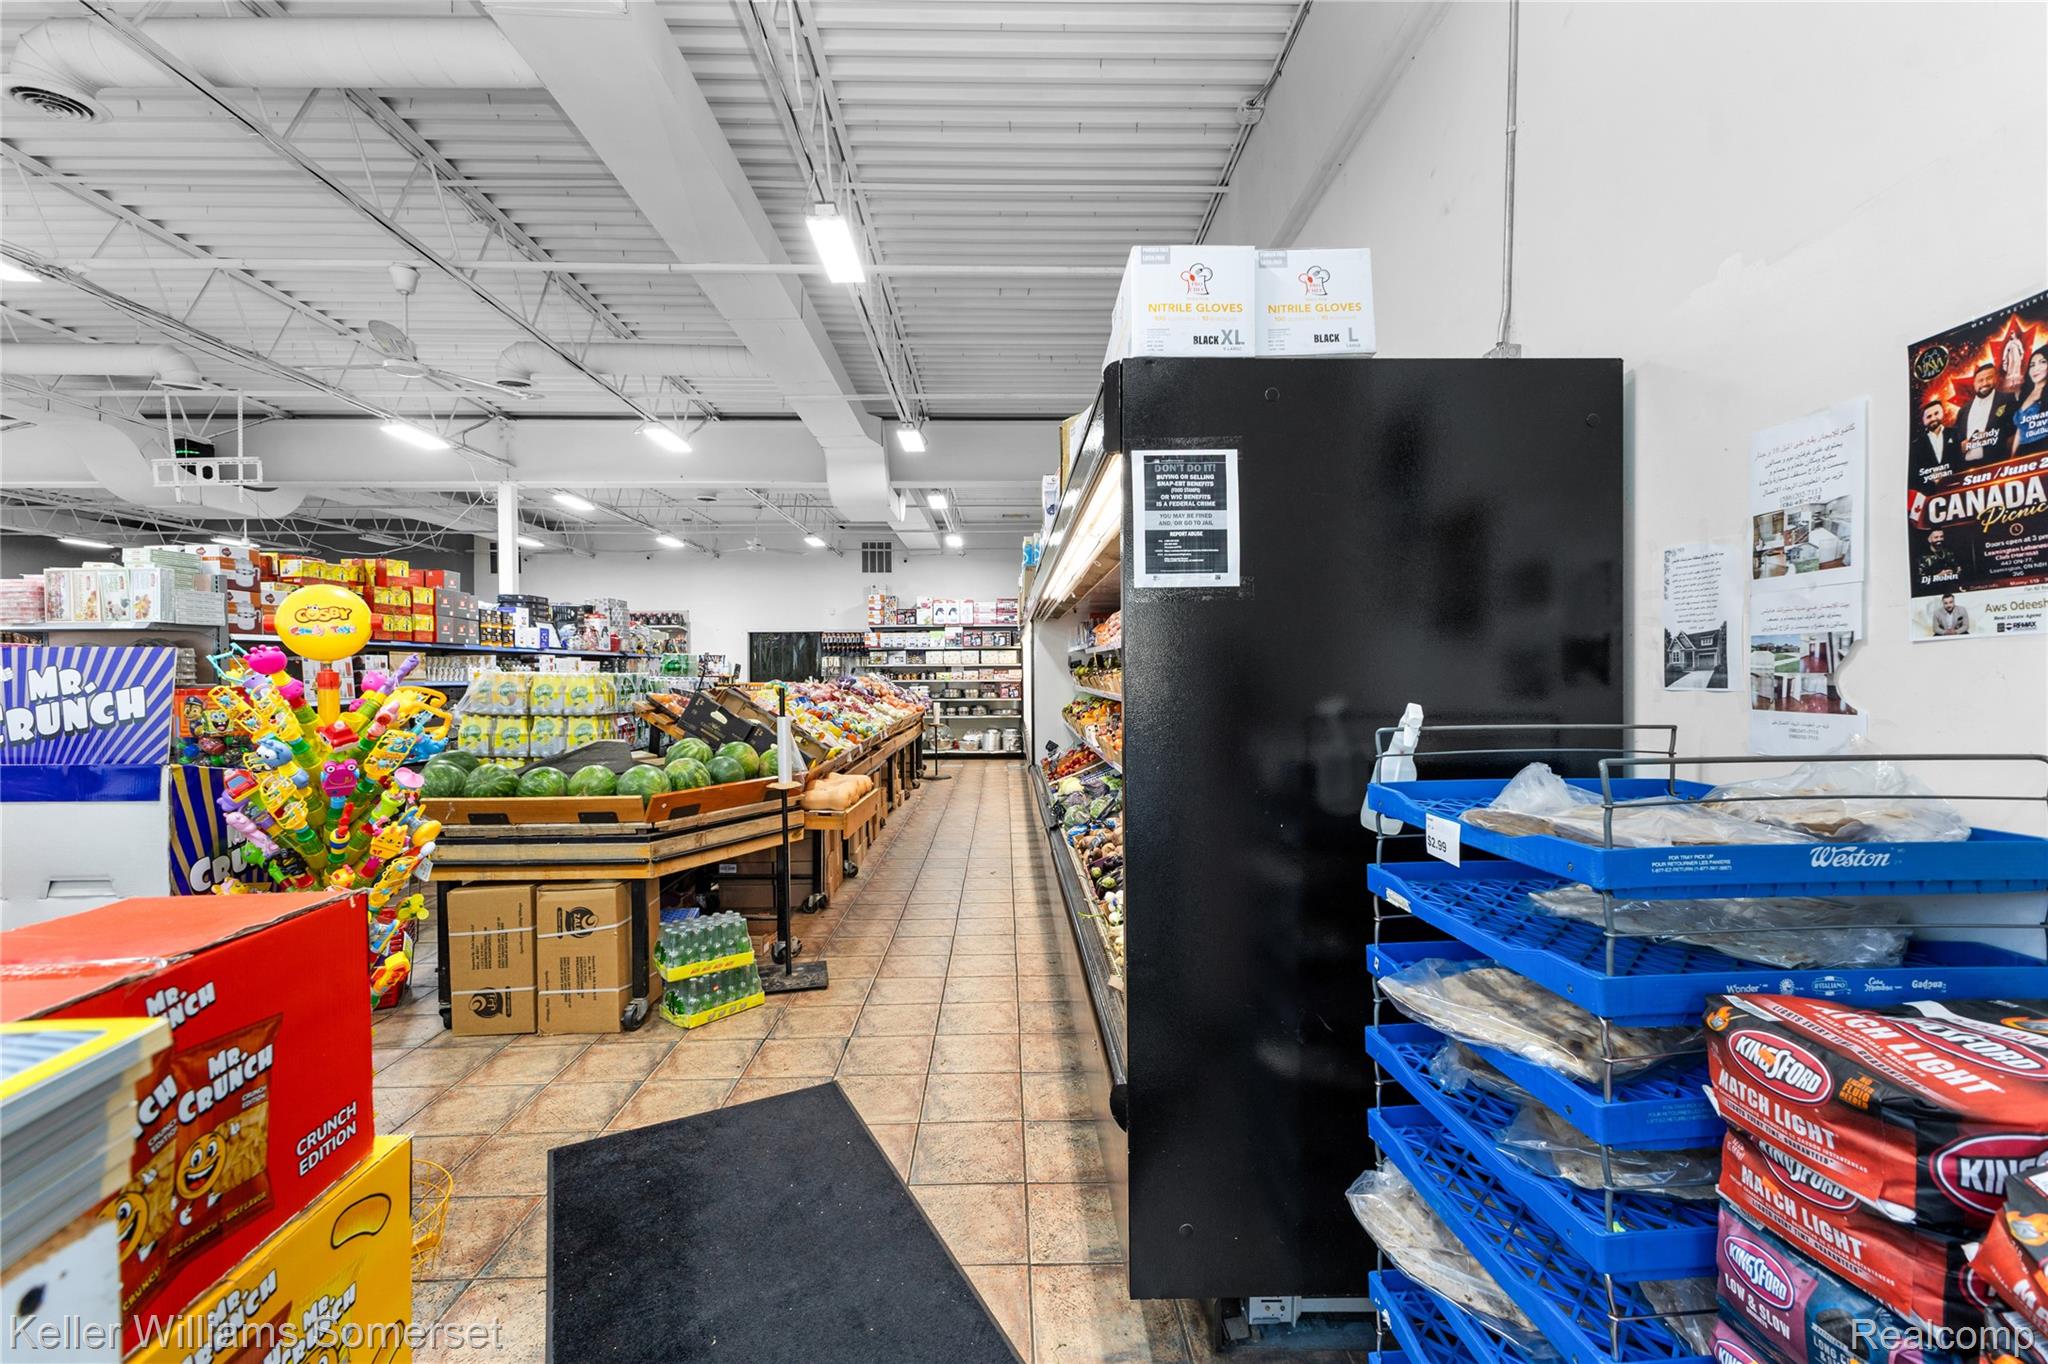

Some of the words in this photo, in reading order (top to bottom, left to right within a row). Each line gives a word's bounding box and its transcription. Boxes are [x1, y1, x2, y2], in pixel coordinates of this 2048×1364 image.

[1148, 303, 1192, 313] NITRILE
[1196, 303, 1243, 313] GLOVES
[1268, 304, 1311, 313] NITRILE
[1315, 302, 1362, 312] GLOVES
[1193, 335, 1219, 345] BLACK
[1221, 329, 1245, 345] XL
[1314, 333, 1340, 343] BLACK
[1348, 327, 1359, 342] L
[1972, 428, 2000, 441] Sandy
[1154, 464, 1184, 472] DON'T
[1187, 464, 1202, 472] DO
[1204, 464, 1216, 472] IT!
[1919, 463, 1950, 476] Serwan
[1962, 470, 1991, 486] Sun
[1928, 476, 2048, 524] CANADA
[1977, 501, 2048, 533] Picnic
[1921, 576, 1933, 585] Dj
[295, 605, 352, 623] COSBY
[1985, 604, 2008, 613] Aws
[27, 664, 97, 702] MR.
[0, 686, 146, 744] RUNCH
[1427, 835, 1447, 853] $2.99
[1810, 846, 1891, 868] Weston
[1726, 984, 1760, 993] Wonder
[165, 981, 217, 1030] NCH
[1773, 1005, 1802, 1022] LIGHTS
[1802, 1020, 1829, 1036] EVERY
[1805, 1003, 1902, 1040] ATCH
[1887, 1042, 2006, 1095] LIGHT
[208, 1047, 249, 1080] MR.
[177, 1043, 274, 1124] CRUNCH
[1842, 1083, 1870, 1102] FLUID
[1718, 1068, 1770, 1117] MATCH
[1774, 1104, 1837, 1150] LIGHT
[296, 1102, 357, 1156] CRUNCH
[299, 1120, 357, 1177] EDITION
[1741, 1165, 1797, 1219] MATCH
[1802, 1208, 1862, 1260] LIGHT
[1728, 1242, 1788, 1301] KINGSFORD
[1725, 1273, 1745, 1302] LOW
[1748, 1294, 1757, 1312] &
[1760, 1303, 1790, 1340] SLOW
